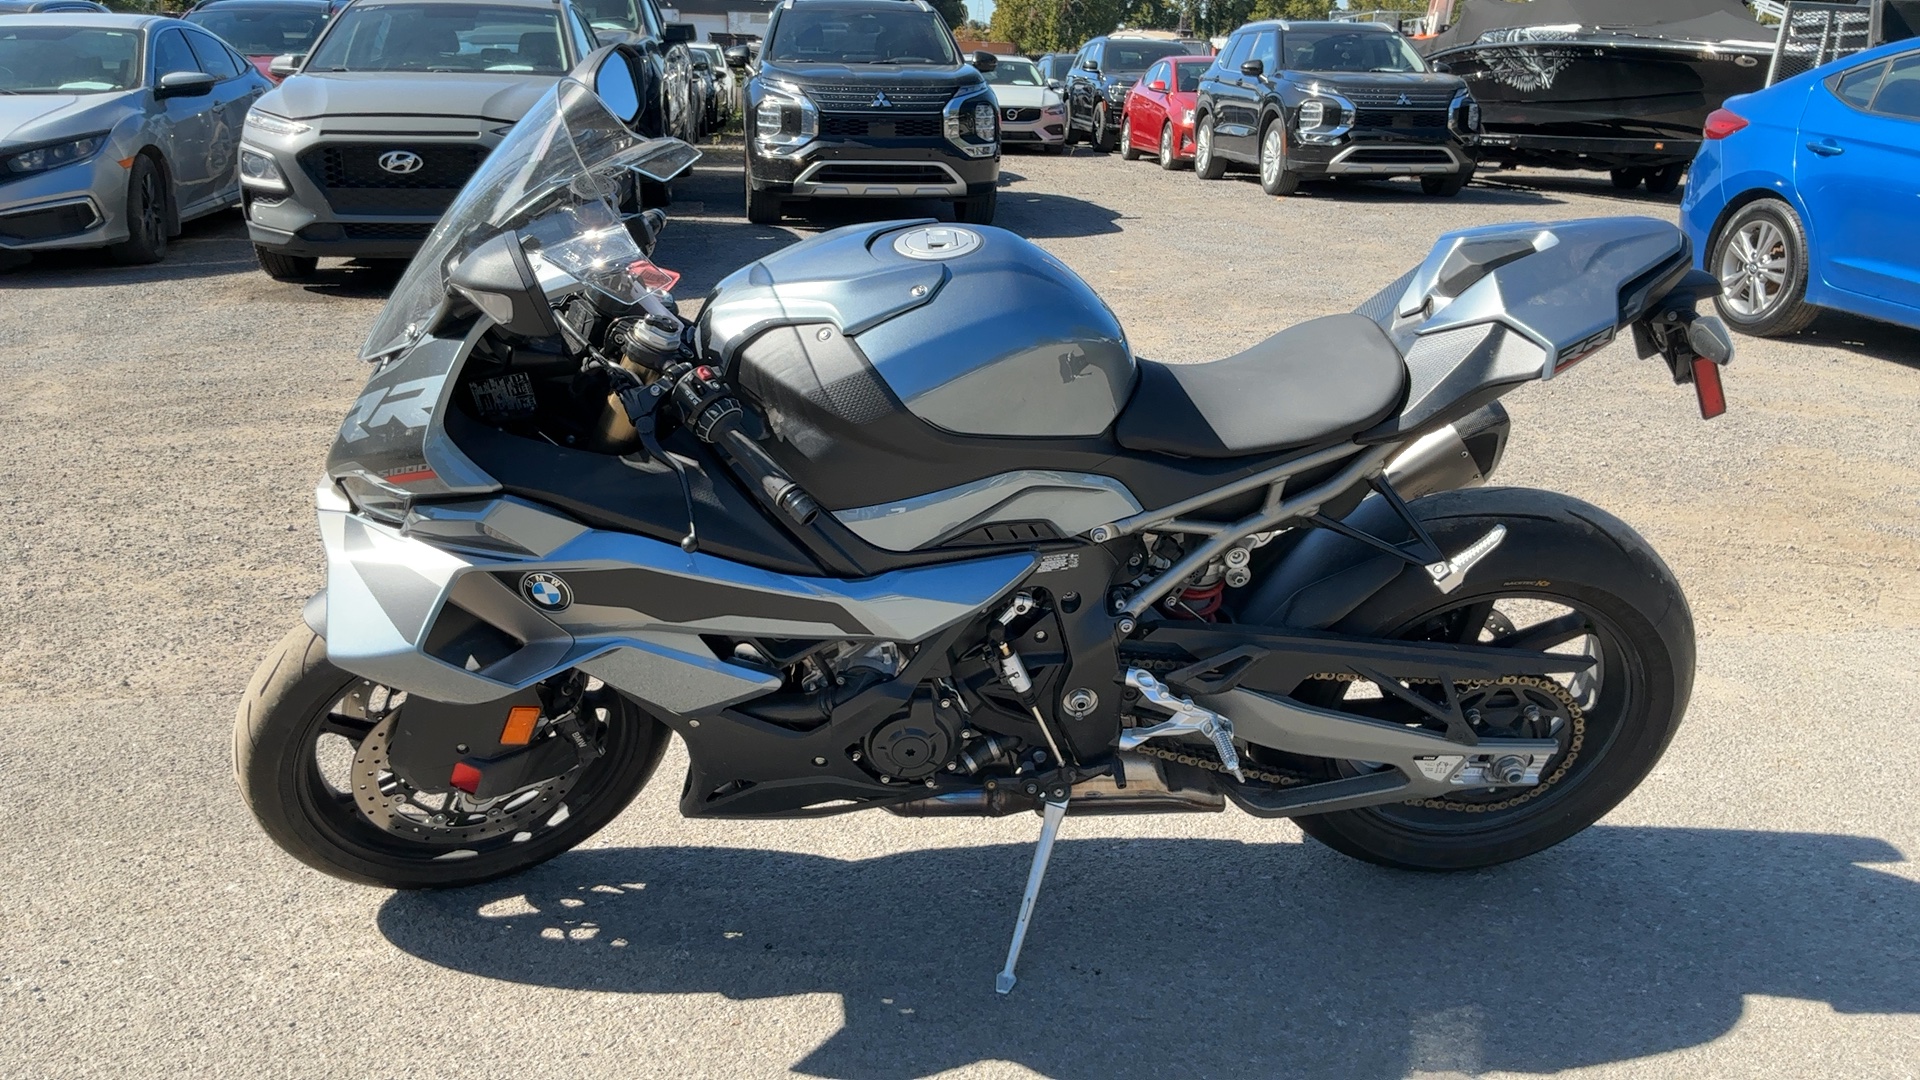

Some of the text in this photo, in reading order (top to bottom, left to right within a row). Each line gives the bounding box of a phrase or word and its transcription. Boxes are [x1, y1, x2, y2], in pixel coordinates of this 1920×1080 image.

[1556, 326, 1613, 366] RR
[524, 574, 561, 588] BMW
[571, 731, 588, 748] BMW
